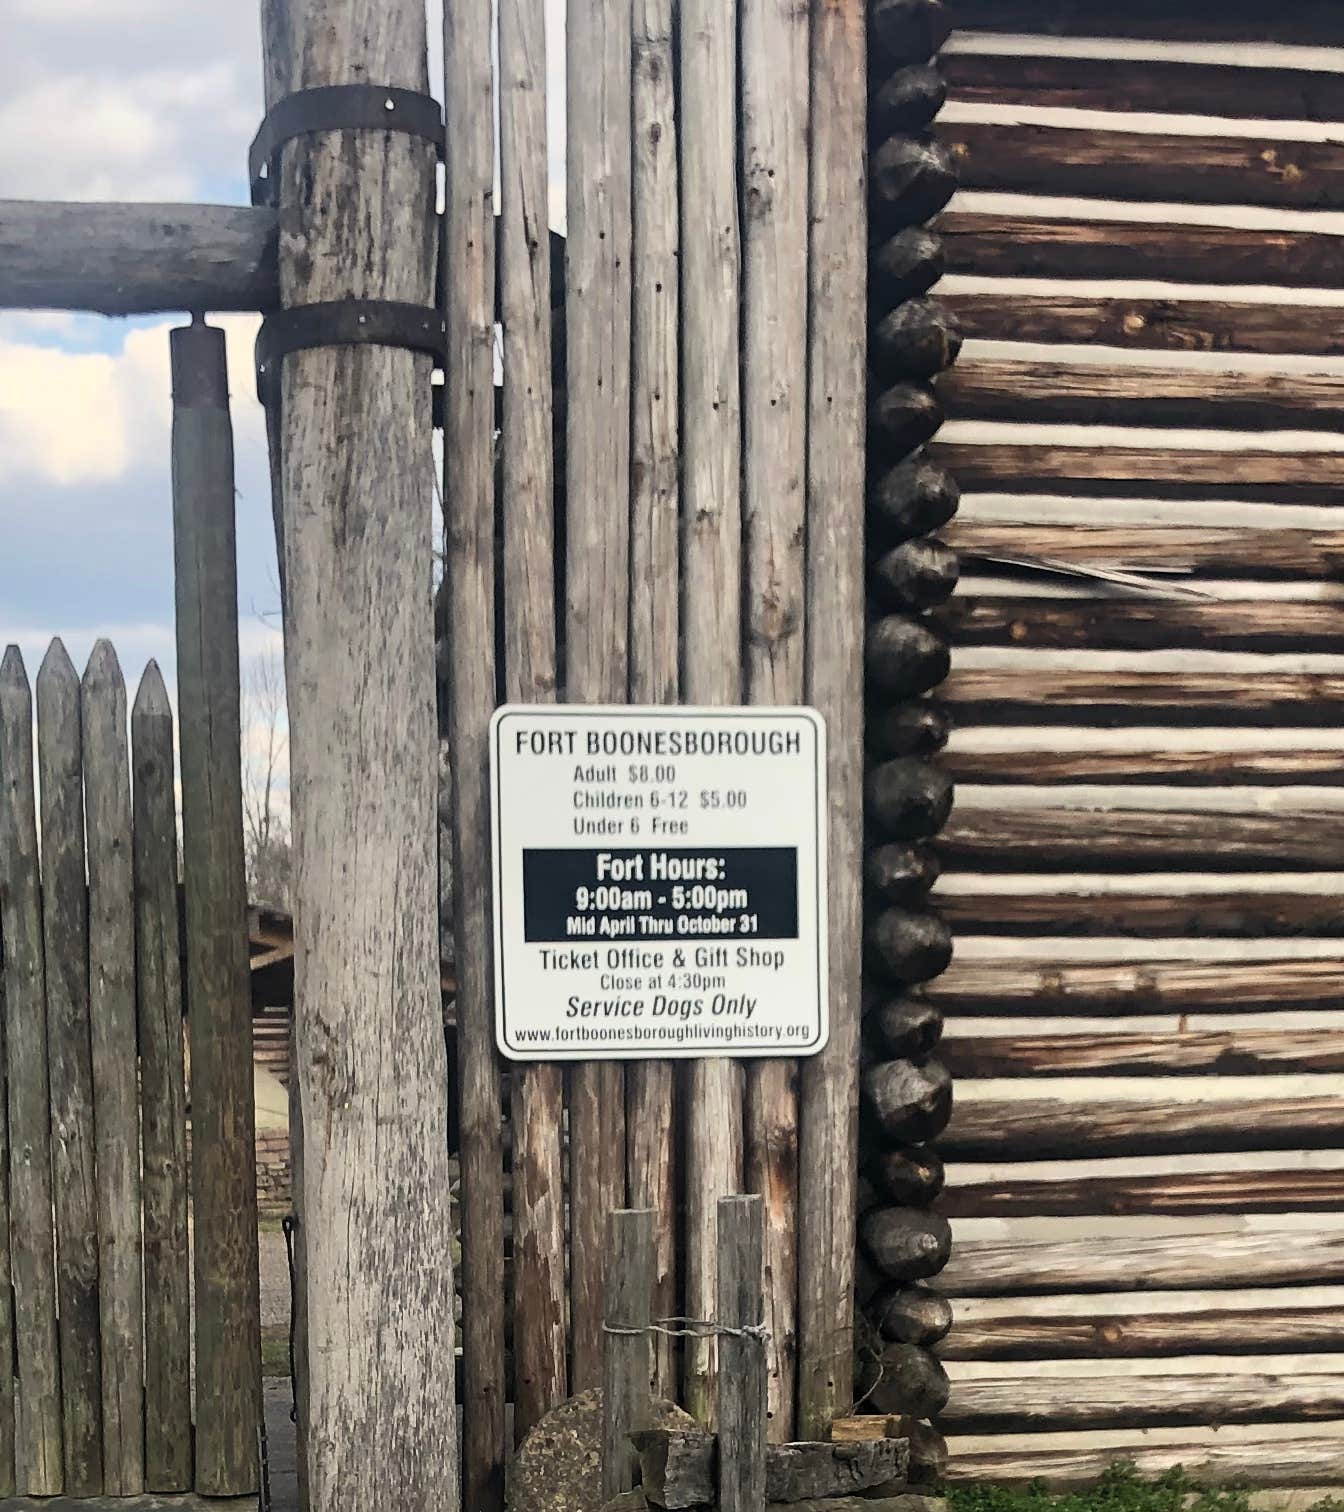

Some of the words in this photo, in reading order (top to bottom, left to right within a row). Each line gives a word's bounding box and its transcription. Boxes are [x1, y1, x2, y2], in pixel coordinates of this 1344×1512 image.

[516, 731, 577, 755] FORT
[587, 730, 800, 756] BOONESBOROUGH
[574, 766, 617, 783] Adult
[628, 765, 676, 783] $8.00
[573, 791, 644, 809] Children
[650, 791, 688, 809] 6-12
[700, 789, 747, 809] $5.00
[574, 817, 623, 835] Under
[630, 817, 640, 834] 6
[652, 817, 689, 834] Free
[597, 853, 644, 881] Fort
[651, 853, 726, 881] Hours:
[576, 887, 652, 911] 9:00am
[672, 886, 748, 913] 5:00pm
[567, 917, 595, 935] Mid
[600, 916, 636, 937] April
[639, 916, 673, 934] Thru
[677, 915, 736, 934] October
[739, 914, 758, 933] 31
[539, 950, 600, 970] Ticket
[606, 949, 664, 968] Office
[673, 949, 686, 968] &
[695, 948, 728, 967] Gift
[736, 948, 785, 971] Shop
[600, 974, 642, 990] Close
[648, 975, 662, 990] at
[667, 974, 726, 992] 4:30pm
[566, 997, 644, 1018] Service
[652, 997, 703, 1020] Dogs
[712, 993, 757, 1019] Only
[515, 1023, 810, 1043] www.fortboonesboroughlivinghistory.org
